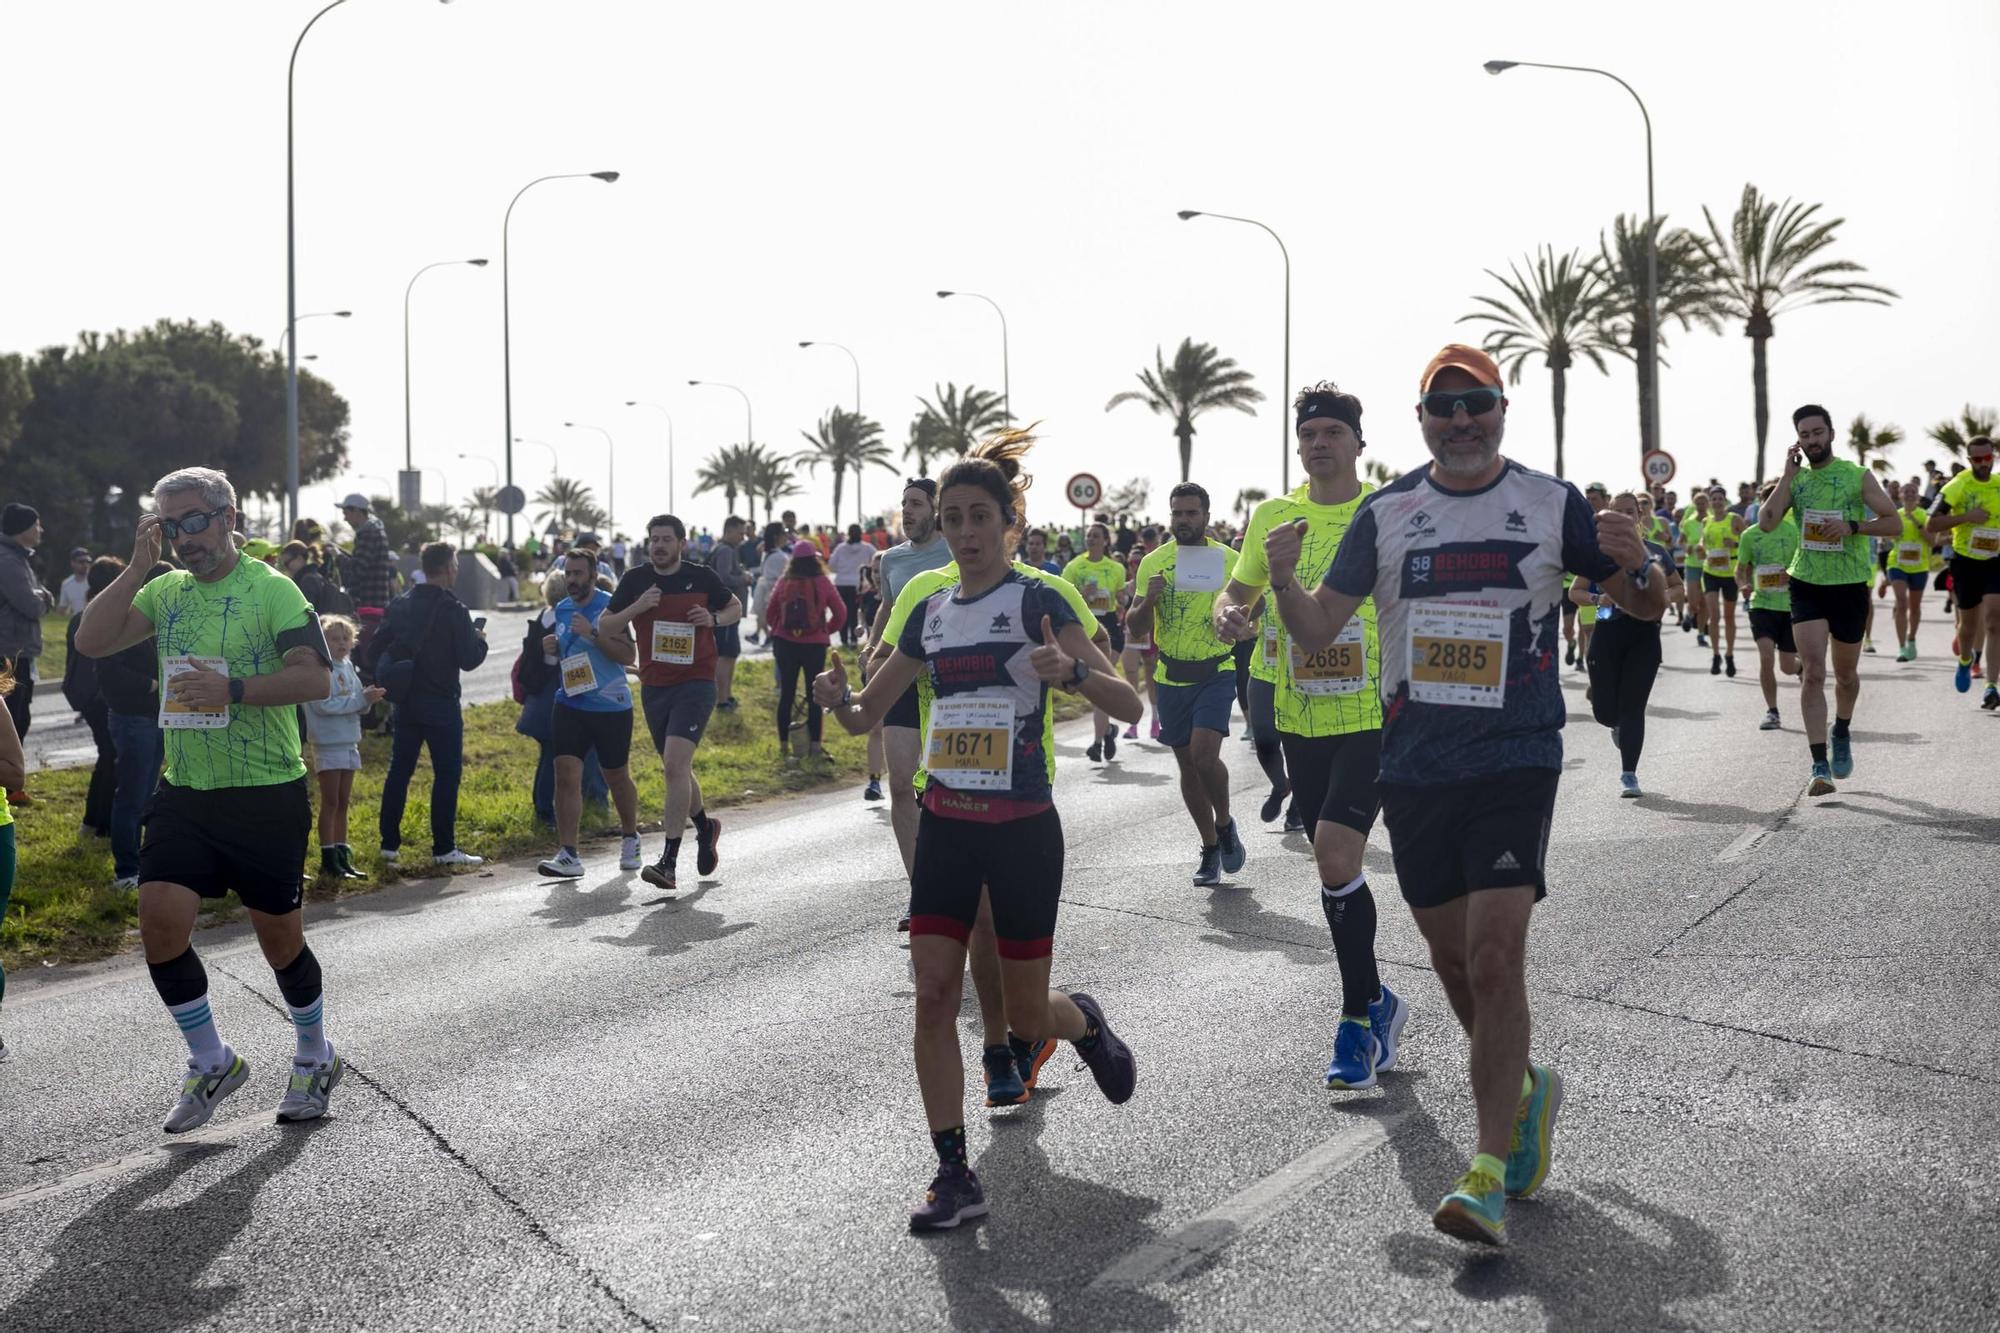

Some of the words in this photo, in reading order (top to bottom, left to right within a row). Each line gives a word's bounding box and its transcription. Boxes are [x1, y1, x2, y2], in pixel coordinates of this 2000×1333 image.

[1650, 462, 1669, 475] 60
[1074, 485, 1095, 498] 60
[1411, 556, 1431, 571] 58
[1435, 553, 1509, 570] BEHOBIA
[662, 637, 688, 649] 2162
[938, 655, 995, 673] BEHOBIA
[1305, 648, 1351, 669] 2685
[1428, 642, 1487, 671] 2885
[945, 733, 993, 755] 1671
[942, 799, 990, 812] HANKER
